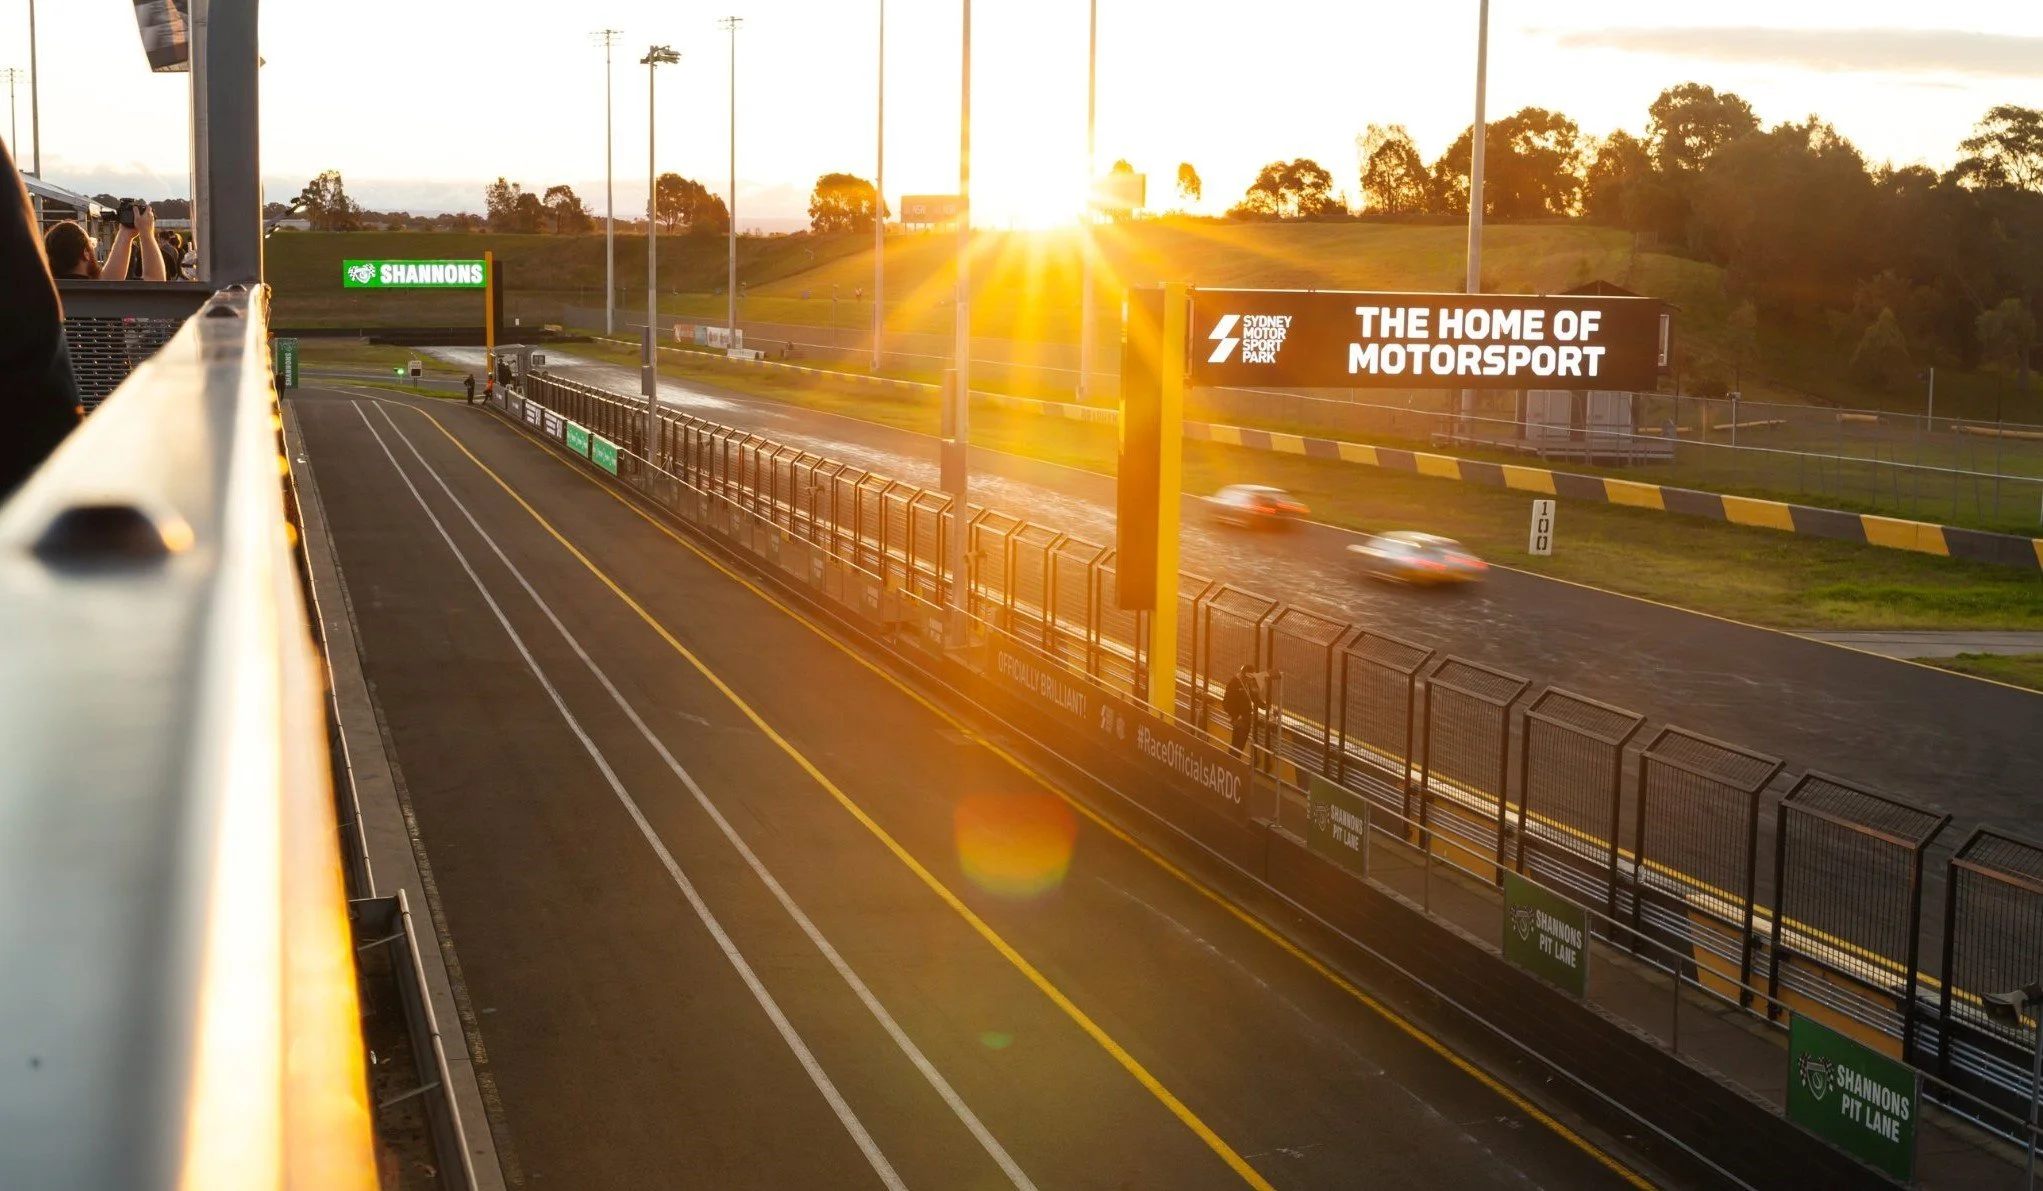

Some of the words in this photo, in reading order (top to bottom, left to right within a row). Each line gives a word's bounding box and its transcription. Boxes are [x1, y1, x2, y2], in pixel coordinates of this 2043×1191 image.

[380, 264, 483, 284] SHANNONS
[1243, 315, 1293, 328] SYDNEY
[1243, 327, 1286, 340] MOTOR
[1355, 307, 1430, 339] THE
[1438, 308, 1545, 340] HOME
[1553, 310, 1602, 341] OF
[1242, 351, 1276, 364] PARK
[1243, 339, 1283, 352] SPORT
[1348, 343, 1606, 377] MOTORSPORT
[998, 650, 1040, 693] OFFICIALLY
[1041, 674, 1087, 719] BRILLIANT!
[1137, 723, 1241, 804] #RaceOfficialsARDC
[1331, 804, 1363, 836] SHANNONS
[1333, 824, 1342, 841] PIT
[1344, 829, 1359, 852] LANE
[1536, 909, 1582, 949] SHANNONS
[1540, 933, 1552, 955] PIT
[1555, 941, 1577, 968] LANE
[1837, 1064, 1910, 1121] SHANNONS
[1841, 1093, 1862, 1122] PIT
[1866, 1106, 1900, 1143] LANE
